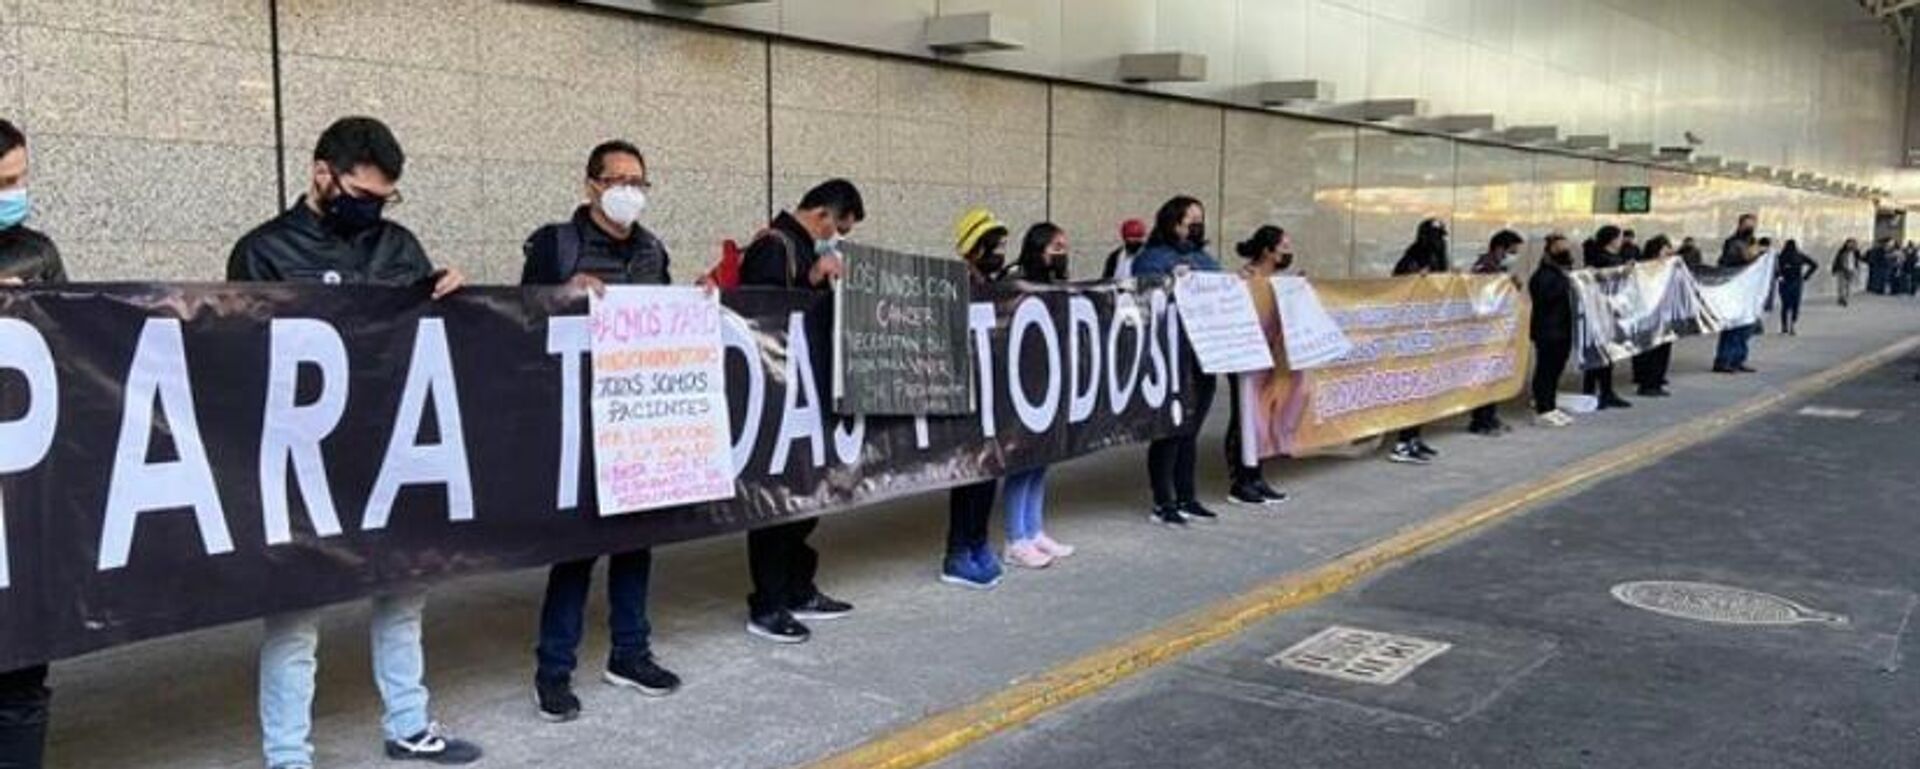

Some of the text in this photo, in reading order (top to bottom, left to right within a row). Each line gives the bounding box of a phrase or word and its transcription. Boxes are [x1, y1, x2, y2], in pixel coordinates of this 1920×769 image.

[650, 371, 708, 395] SOMOS
[607, 398, 710, 423] PACIENTES
[0, 317, 473, 588] PARA
[967, 288, 1183, 437] TODOS!
